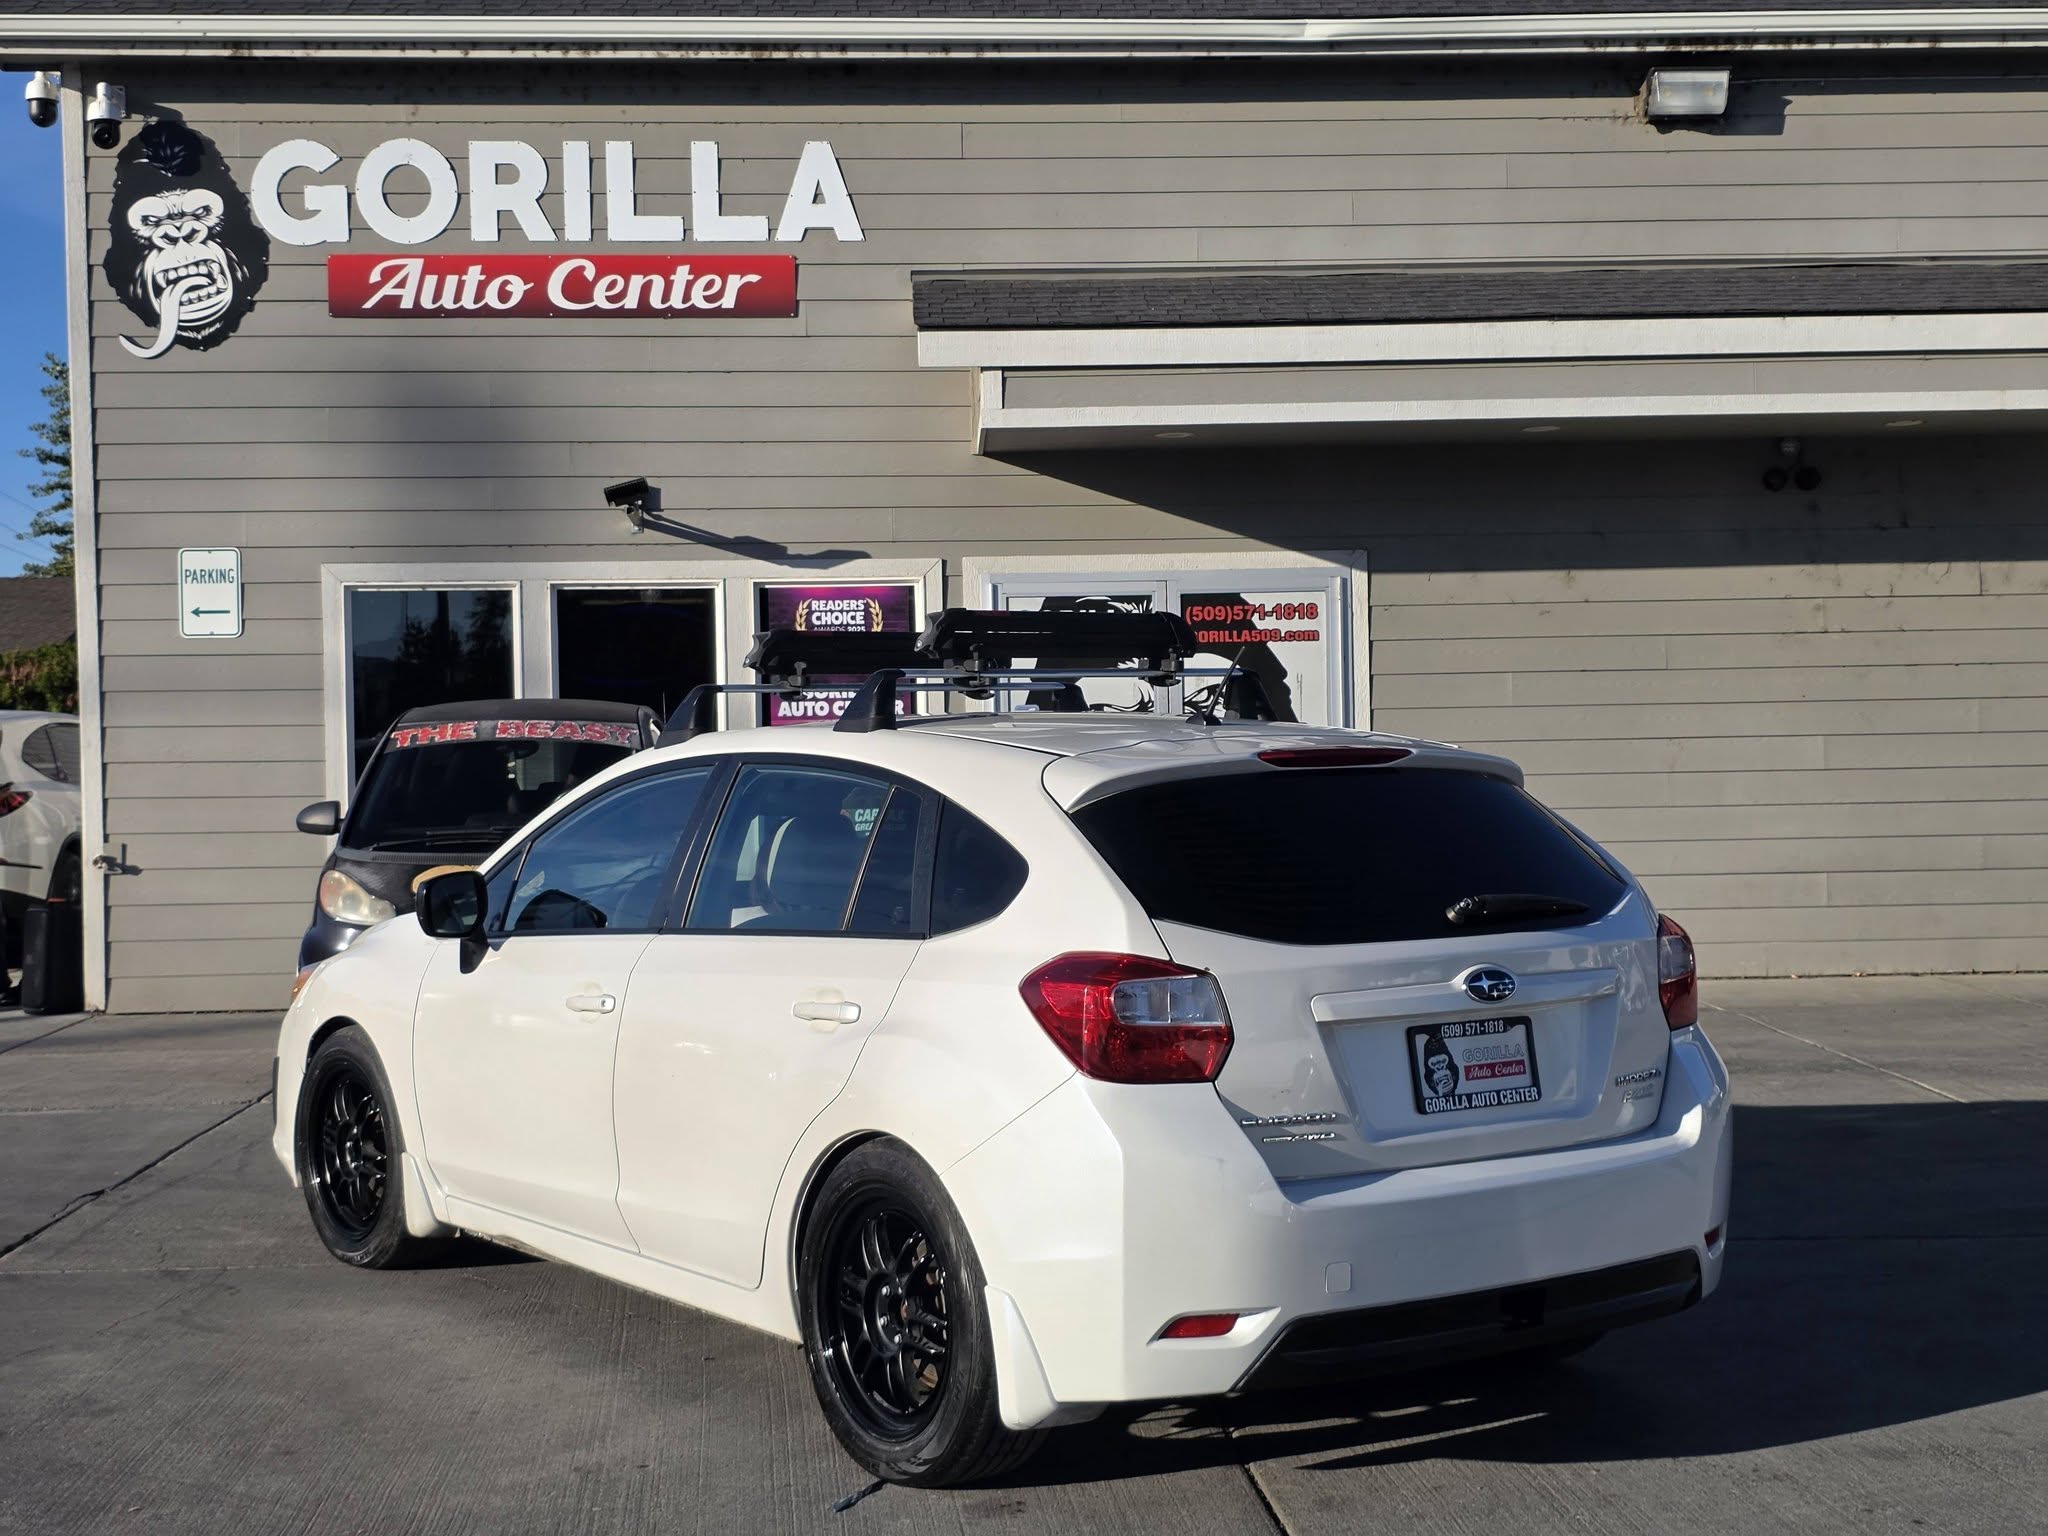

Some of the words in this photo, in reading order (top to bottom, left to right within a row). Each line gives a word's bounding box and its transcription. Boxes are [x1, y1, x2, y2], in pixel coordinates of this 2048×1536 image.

[251, 138, 865, 245] GORILLA
[361, 258, 534, 310] Auto
[547, 258, 762, 310] Center
[184, 568, 235, 584] PARKING
[811, 599, 867, 611] READERS'
[811, 611, 865, 625] CHOICE
[1185, 602, 1319, 626] (509)571-1818
[1195, 628, 1320, 644] ORILLA509.com
[777, 700, 829, 717] AUTO
[390, 720, 479, 748] THE
[496, 720, 638, 744] BEAST
[1441, 1023, 1463, 1037] (509)
[1466, 1020, 1504, 1036] 571-1818
[1462, 1043, 1525, 1063] GORILLA
[1469, 1065, 1492, 1079] Auto
[1495, 1063, 1524, 1076] Center
[1425, 1094, 1469, 1113] GORILLA
[1471, 1091, 1498, 1107] AUTO
[1500, 1087, 1539, 1104] CENTER
